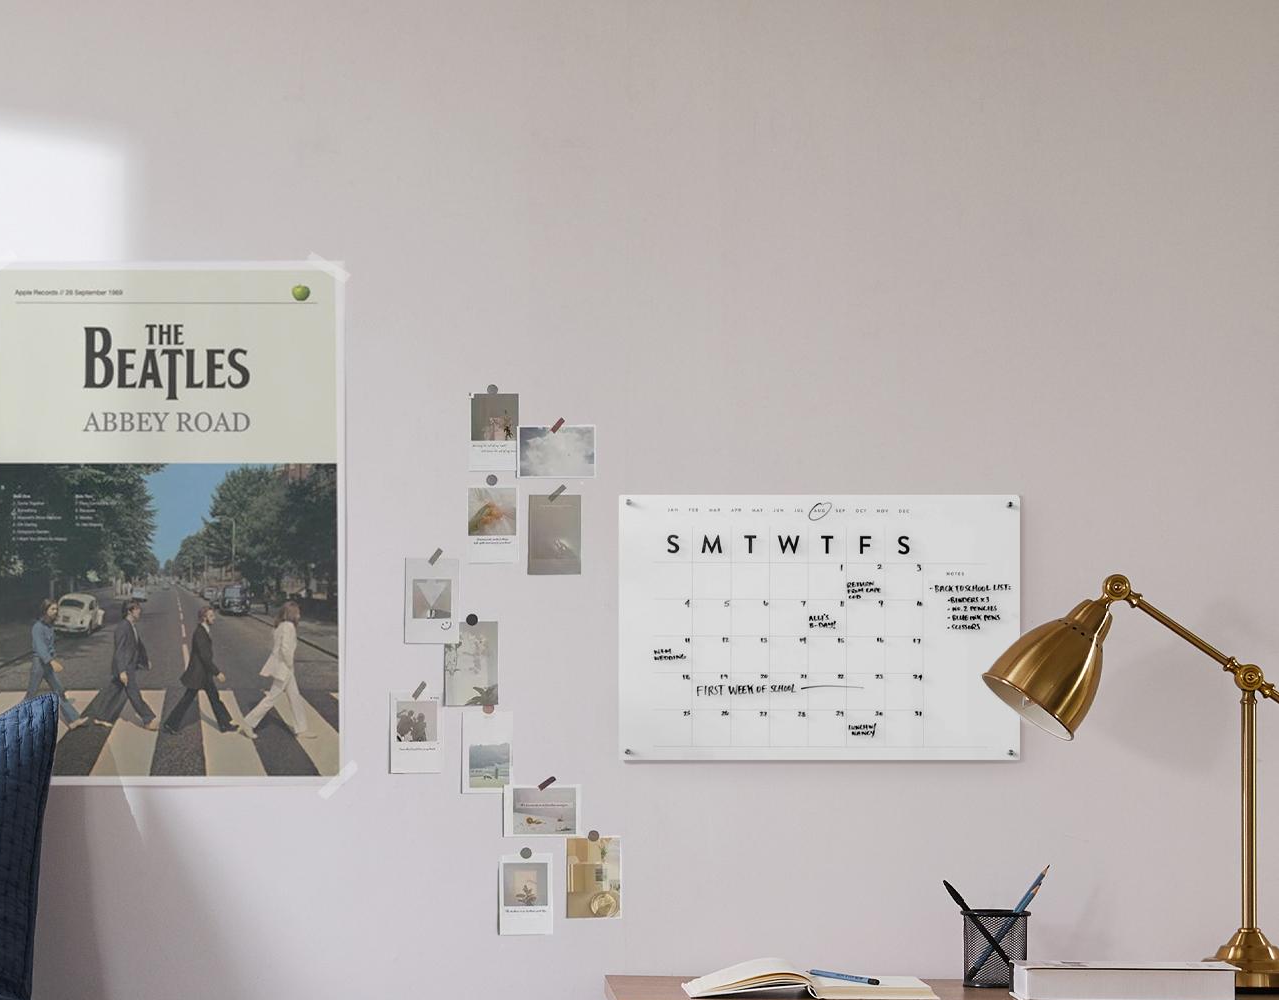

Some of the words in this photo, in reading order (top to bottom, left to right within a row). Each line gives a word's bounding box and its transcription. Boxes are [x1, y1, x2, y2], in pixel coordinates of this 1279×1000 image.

[145, 324, 184, 345] THE
[83, 326, 251, 401] BEATLES
[82, 412, 170, 433] ABBEY
[176, 412, 251, 433] ROAD
[667, 535, 679, 554] S
[702, 535, 723, 554] M
[744, 535, 756, 554] T
[778, 535, 801, 554] W
[821, 536, 833, 554] T
[860, 536, 871, 554] F
[898, 536, 910, 555] S
[916, 564, 922, 572] 3
[934, 584, 954, 593] BACK
[964, 584, 991, 593] SCHOOL
[696, 684, 726, 696] FIRST
[728, 684, 754, 695] WEEK
[756, 685, 767, 694] OF
[770, 684, 797, 694] SCHOOL
[851, 730, 875, 738] NANCY
